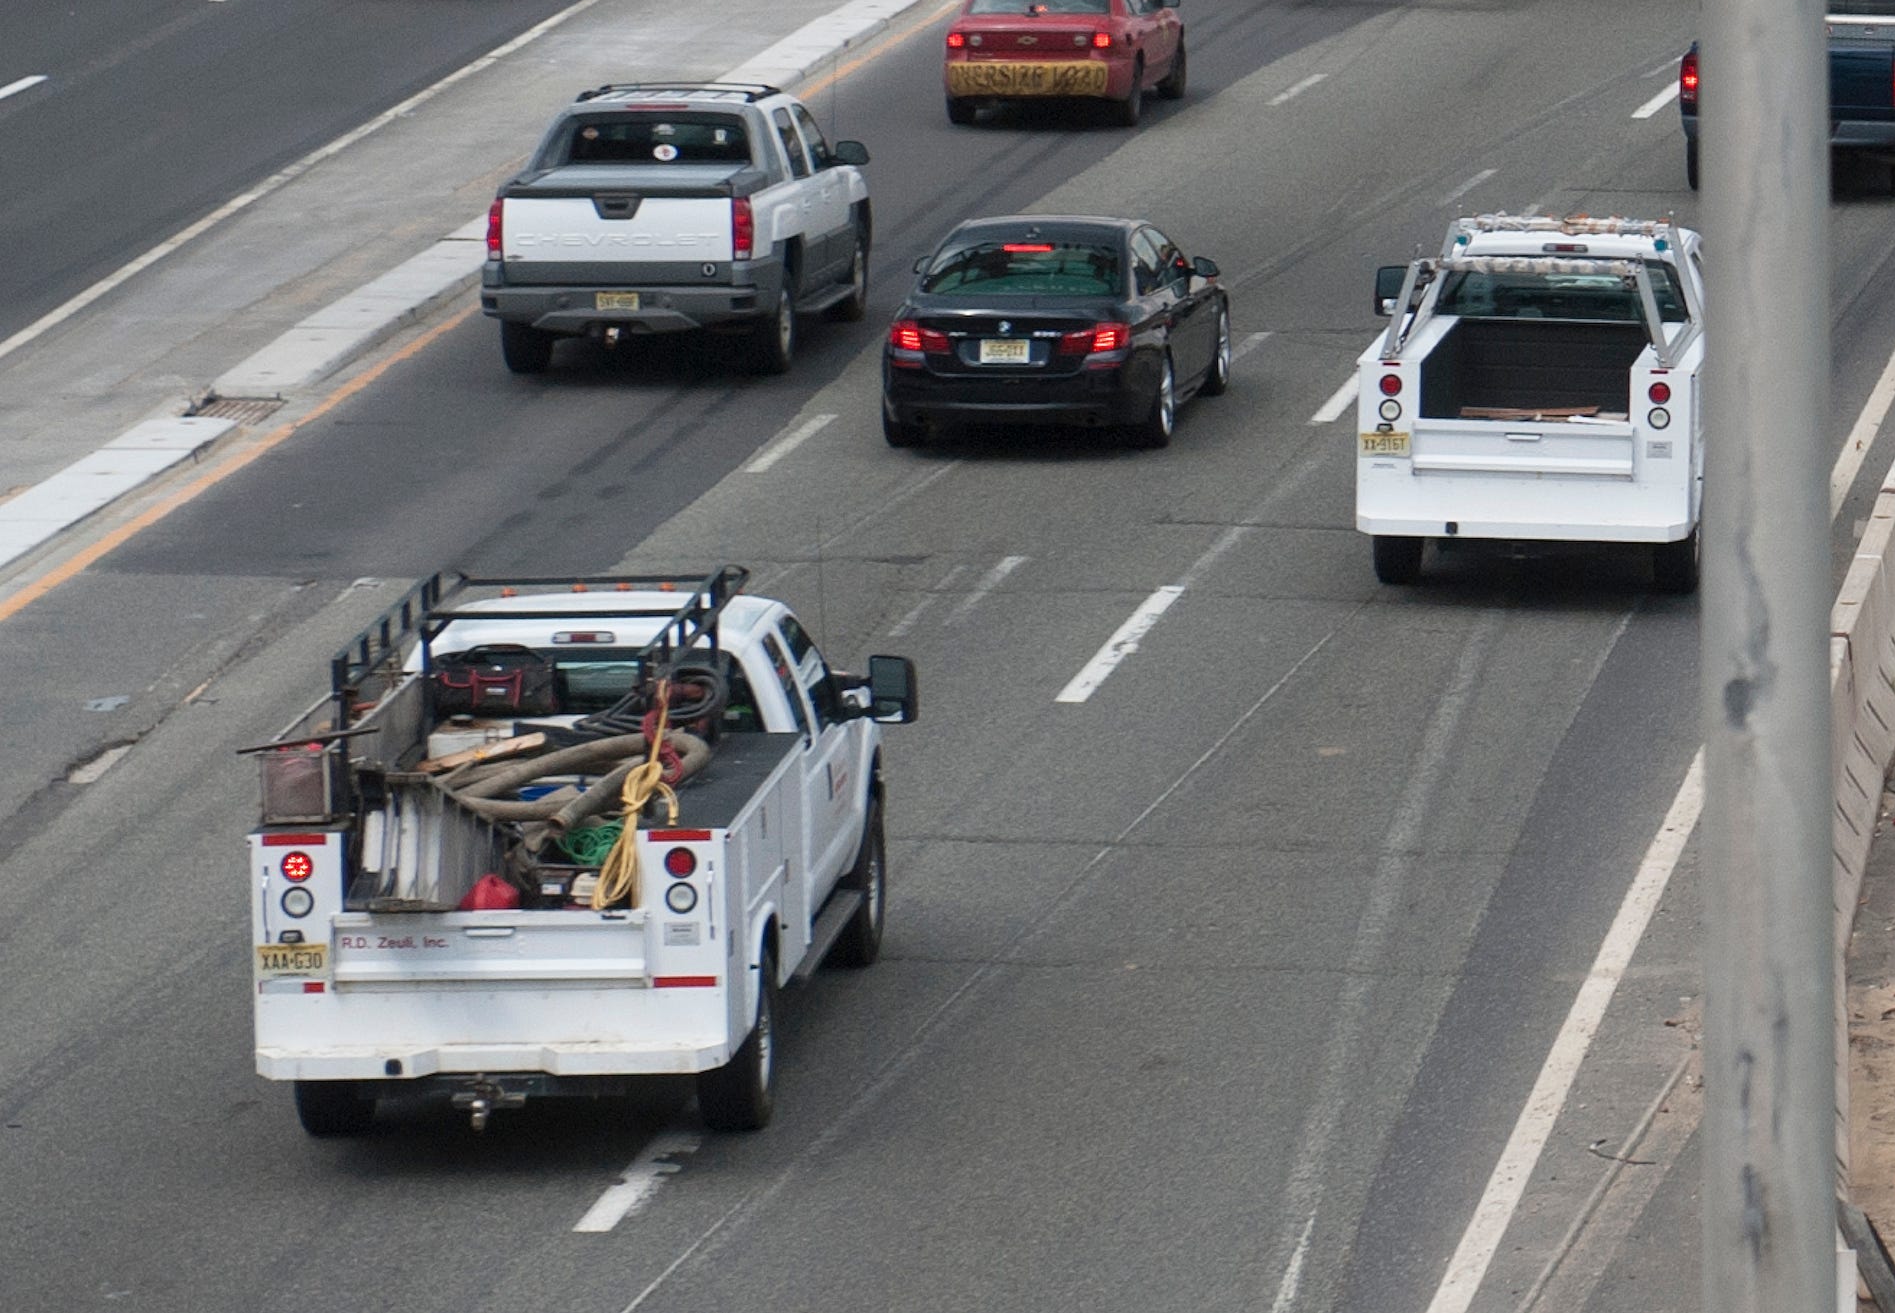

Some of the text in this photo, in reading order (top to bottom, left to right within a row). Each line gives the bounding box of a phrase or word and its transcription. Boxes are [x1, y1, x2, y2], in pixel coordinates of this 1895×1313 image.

[950, 64, 1107, 91] OVERSIZE LOAD
[515, 232, 720, 248] CHEVROLET
